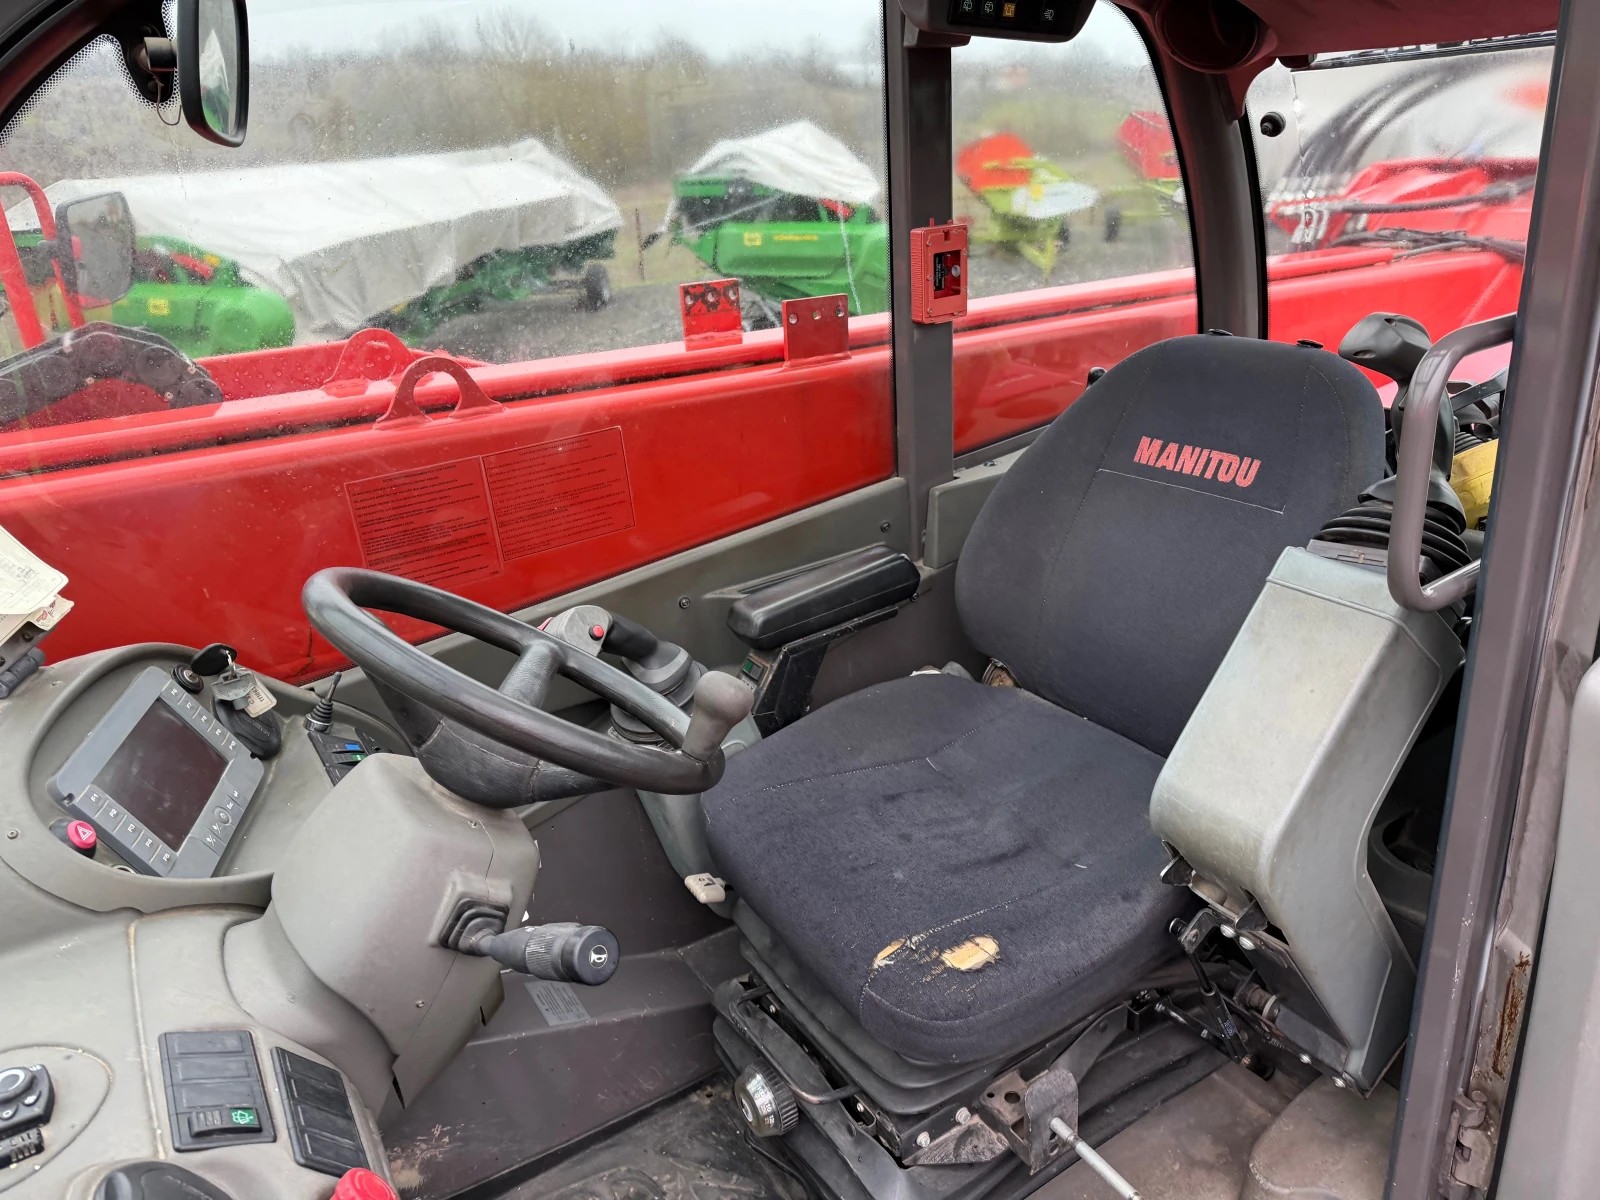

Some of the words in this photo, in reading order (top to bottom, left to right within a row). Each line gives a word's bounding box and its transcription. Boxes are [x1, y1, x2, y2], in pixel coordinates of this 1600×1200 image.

[1133, 435, 1261, 488] MANITOU
[90, 793, 99, 803] F1
[109, 808, 118, 818] F2
[127, 823, 136, 833] F3
[145, 838, 153, 848] F4
